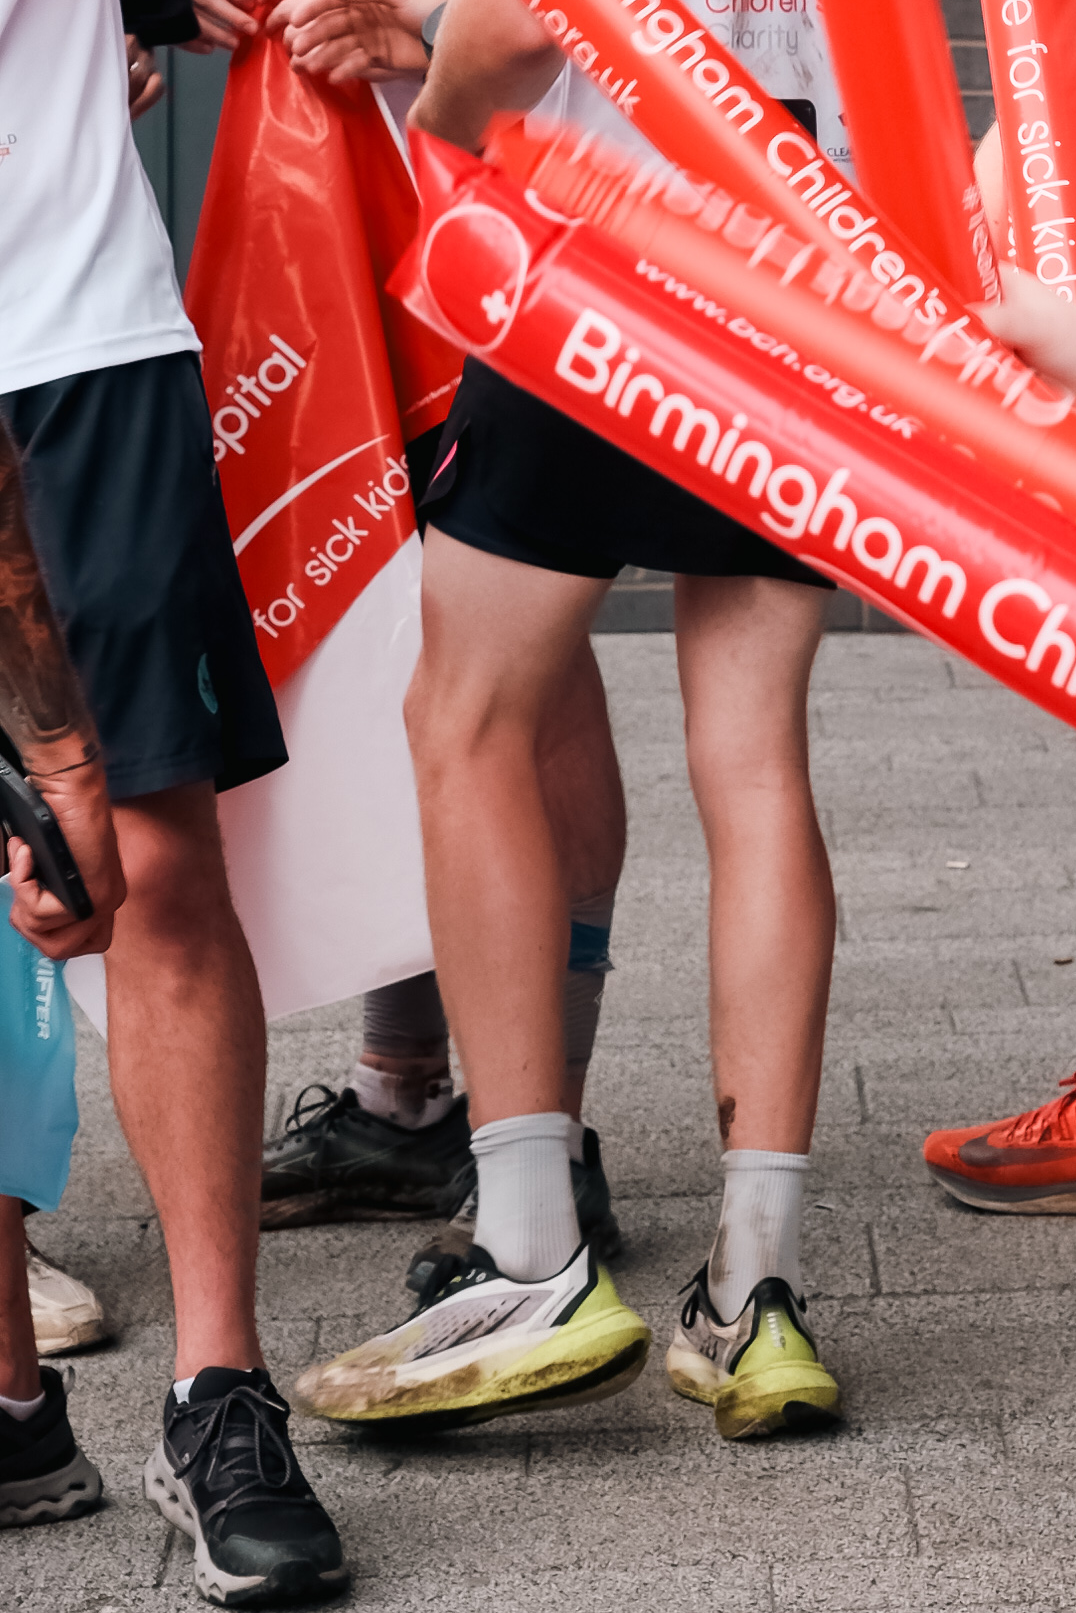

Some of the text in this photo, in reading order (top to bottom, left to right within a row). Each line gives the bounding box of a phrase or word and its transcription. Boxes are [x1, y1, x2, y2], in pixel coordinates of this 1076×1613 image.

[713, 21, 799, 58] Charity
[1007, 39, 1048, 103] for
[1017, 120, 1070, 209] sick
[766, 131, 948, 326] Children's
[552, 307, 969, 620] Birmingham
[252, 582, 305, 639] for
[304, 516, 369, 587] sick
